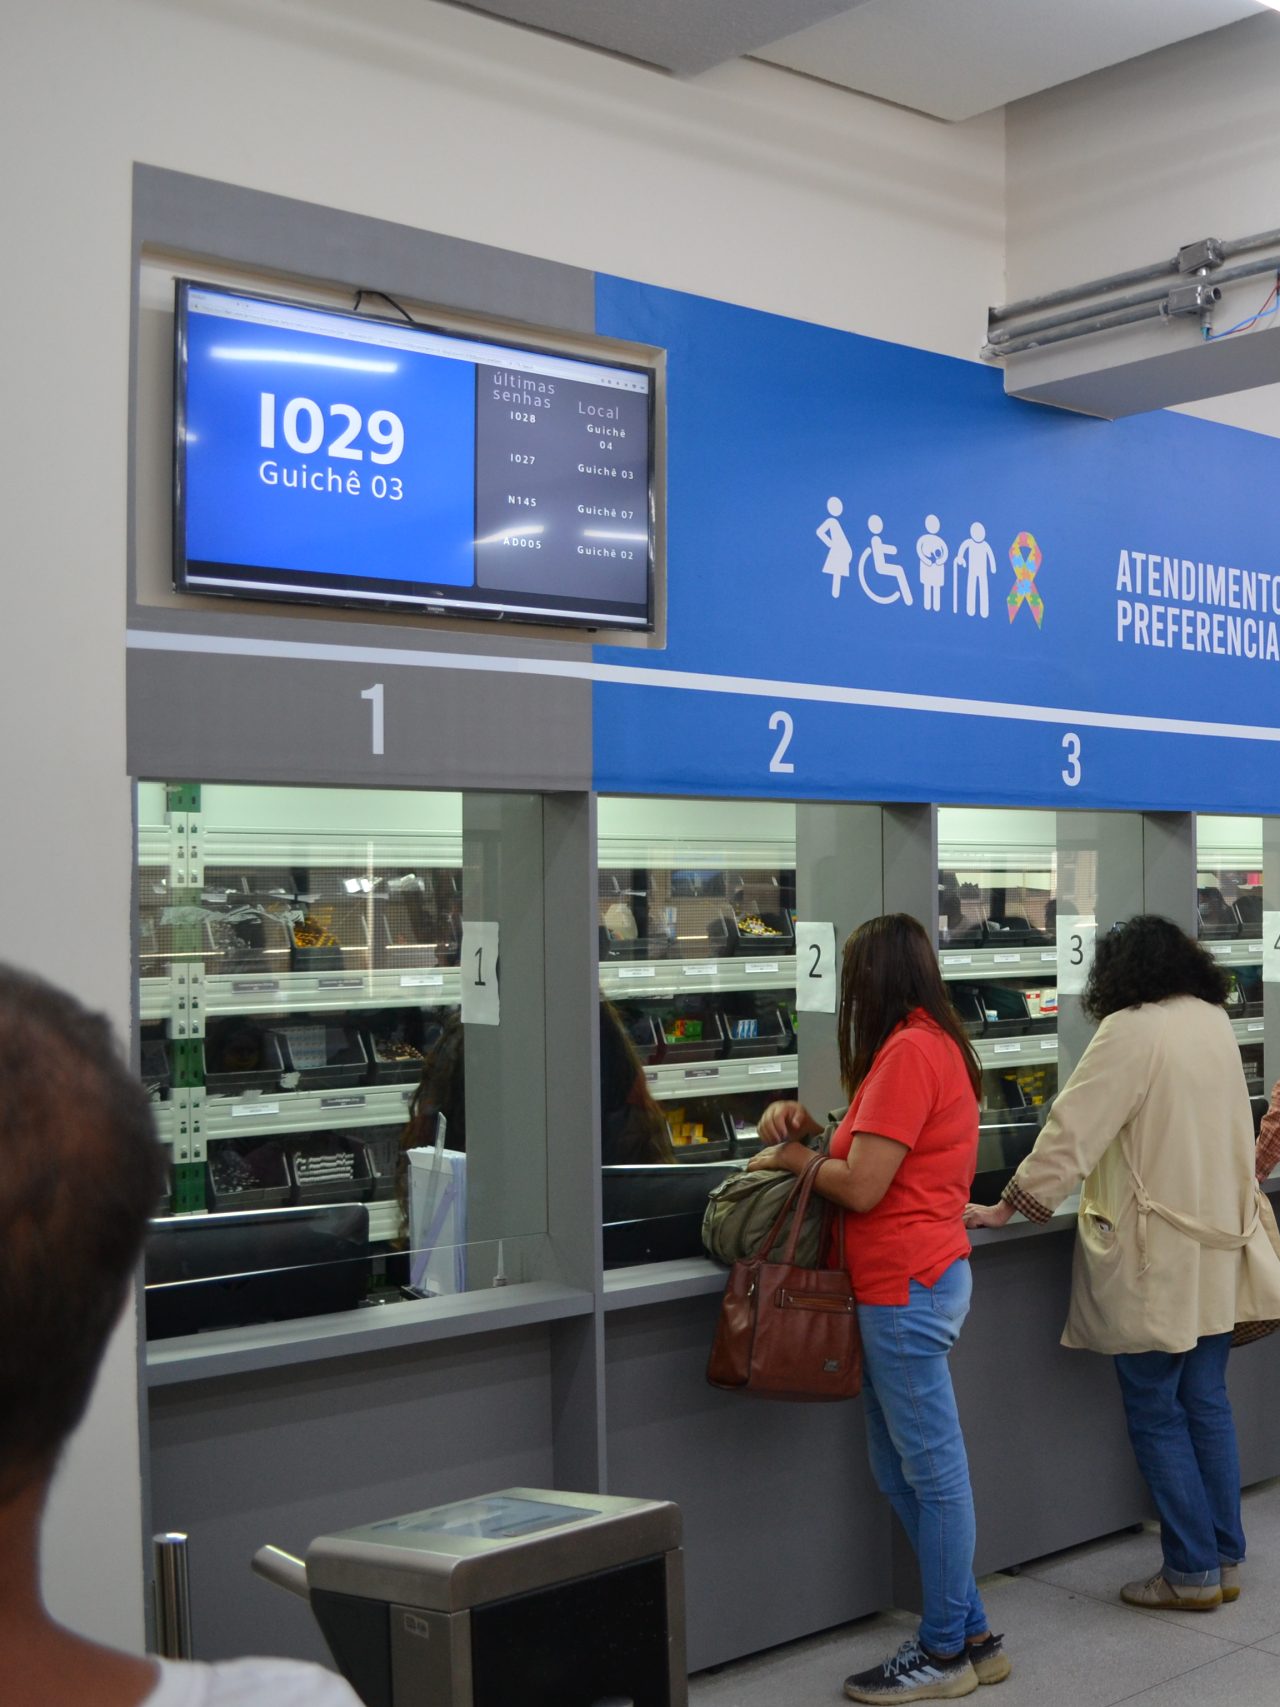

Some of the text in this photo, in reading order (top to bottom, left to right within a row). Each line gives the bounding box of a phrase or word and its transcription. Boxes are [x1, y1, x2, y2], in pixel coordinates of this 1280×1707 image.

[493, 372, 555, 395] últimas
[493, 389, 551, 409] senhas
[578, 401, 619, 420] Local
[261, 392, 405, 465] I029
[587, 424, 626, 438] Guichê
[600, 441, 613, 451] 04
[259, 461, 403, 501] Guichê 03
[578, 463, 634, 480] Guichê 03
[508, 495, 537, 507] N145
[578, 504, 634, 520] Guichê 07
[503, 537, 542, 549] AD005
[577, 545, 634, 560] Guichê 02
[361, 684, 384, 754] 1
[769, 711, 795, 773] 2
[1061, 733, 1081, 787] 3
[1070, 934, 1084, 965] 3
[474, 947, 486, 987] 1
[808, 943, 823, 979] 2
